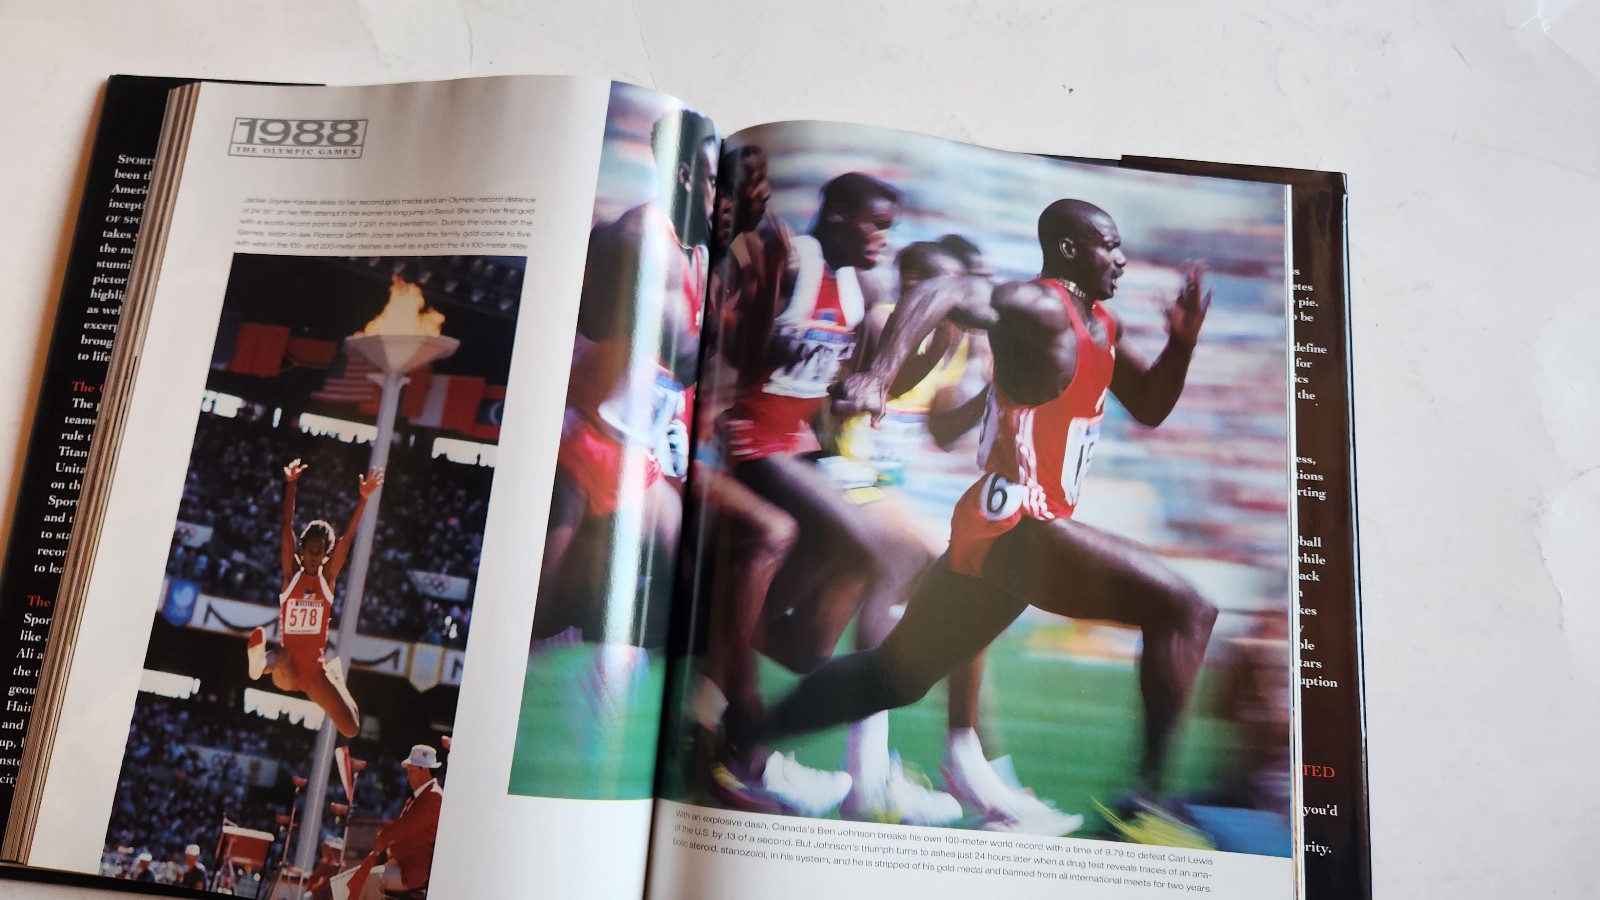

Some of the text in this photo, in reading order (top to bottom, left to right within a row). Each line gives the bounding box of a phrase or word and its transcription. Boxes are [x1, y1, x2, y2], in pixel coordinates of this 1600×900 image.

[239, 119, 359, 146] 1988
[236, 146, 357, 156] THE OLYMPIC GAMES
[114, 168, 140, 179] been
[111, 183, 148, 194] Ameri
[102, 228, 132, 239] takes
[99, 243, 117, 253] the
[92, 273, 127, 285] pictor
[90, 288, 123, 302] highli
[1298, 297, 1319, 308] pie.
[86, 306, 99, 314] as
[1300, 311, 1314, 322] be
[77, 353, 89, 361] to
[1296, 357, 1313, 368] for
[72, 381, 94, 393] The
[1297, 389, 1316, 400] the
[72, 397, 93, 409] The
[61, 430, 84, 441] rule
[58, 445, 87, 457] Titan
[50, 481, 65, 490] on
[986, 471, 1008, 514] 6
[43, 512, 66, 523] and
[41, 530, 53, 539] to
[1298, 535, 1322, 547] ball
[33, 564, 45, 573] to
[1299, 570, 1320, 581] ack
[28, 594, 51, 607] The
[289, 608, 318, 627] 578
[19, 629, 42, 642] like
[16, 647, 34, 659] Ali
[12, 664, 31, 677] the
[1, 719, 24, 730] and
[702, 814, 742, 829] explosive
[816, 826, 836, 835] Ben
[876, 830, 907, 840] breaks
[909, 832, 921, 841] his
[944, 834, 987, 846] 100-meter
[989, 838, 1013, 848] world
[1015, 840, 1044, 850] record
[1045, 842, 1063, 852] with
[1072, 844, 1092, 854] time
[1093, 846, 1103, 855] of
[1104, 847, 1124, 857] 9.79
[1126, 849, 1135, 858] to
[1137, 850, 1166, 861] defeat
[1167, 853, 1186, 863] Carl
[1187, 854, 1213, 865] Lewis
[711, 829, 723, 841] by
[737, 832, 747, 842] of
[795, 838, 811, 847] But
[860, 843, 894, 856] triumph
[895, 845, 918, 855] turns
[920, 847, 929, 856] to
[930, 848, 956, 858] ashes
[956, 850, 972, 861] just
[974, 851, 985, 860] 24
[986, 852, 1011, 861] hours
[1012, 853, 1031, 863] later
[1033, 855, 1057, 865] when
[1066, 857, 1086, 869] drug
[1087, 859, 1104, 869] test
[1106, 861, 1137, 872] reveals
[1138, 864, 1166, 875] traces
[1168, 866, 1177, 876] of
[1178, 869, 1190, 877] an
[1304, 841, 1332, 856] rity.
[688, 839, 718, 853] steroid,
[770, 850, 779, 859] in
[779, 851, 793, 861] his
[795, 852, 831, 866] system,
[833, 855, 851, 865] and
[851, 857, 864, 866] he
[865, 858, 873, 866] is
[874, 858, 910, 871] stripped
[911, 861, 921, 870] of
[921, 861, 935, 870] his
[936, 862, 955, 874] gold
[956, 864, 983, 874] medal
[984, 865, 1001, 875] and
[1001, 867, 1035, 877] banned
[1036, 869, 1057, 879] from
[1058, 871, 1068, 880] all
[1069, 871, 1122, 884] international
[1123, 876, 1151, 887] meets
[1152, 879, 1164, 888] for
[1167, 880, 1184, 890] two
